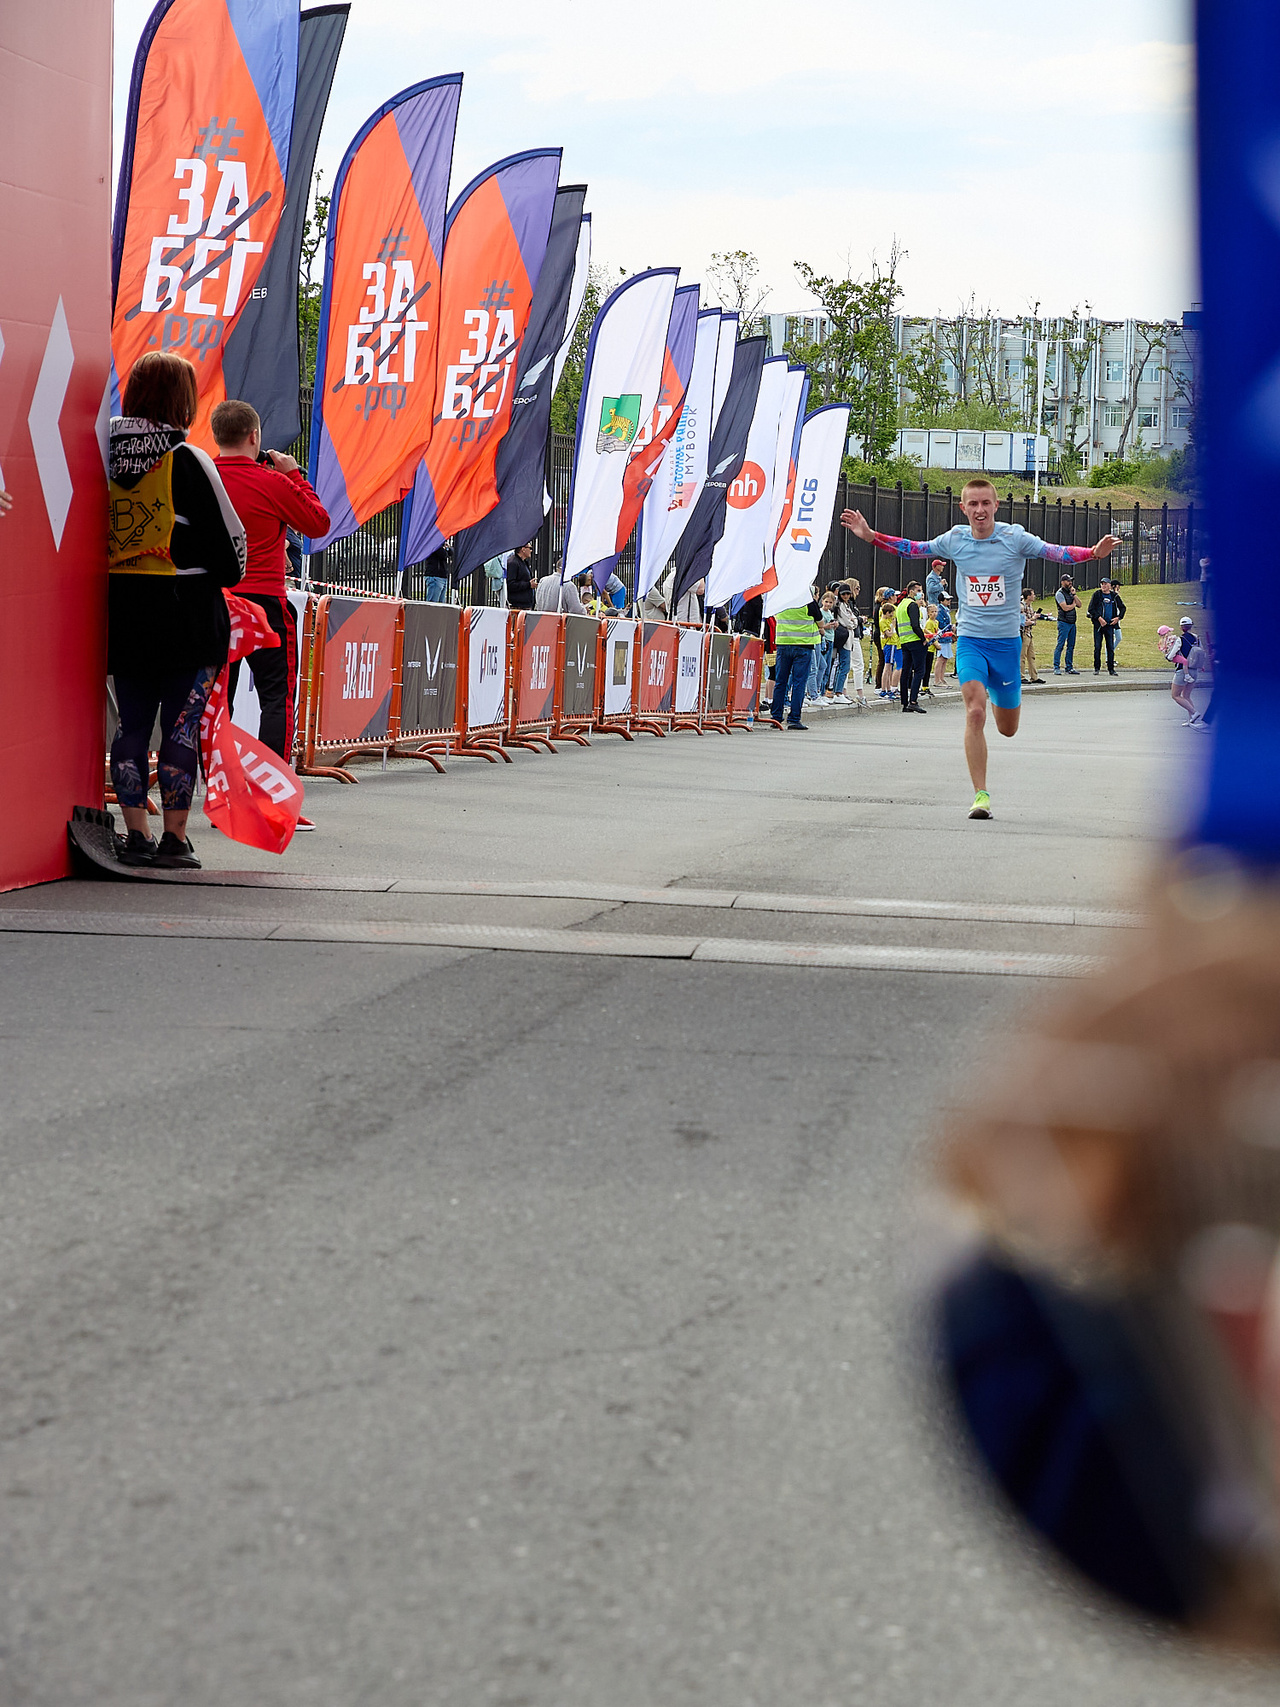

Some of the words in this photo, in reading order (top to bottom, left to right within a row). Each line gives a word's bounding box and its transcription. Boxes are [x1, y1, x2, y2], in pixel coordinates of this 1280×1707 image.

[166, 158, 250, 240] ЗА
[140, 236, 264, 317] БЕГ
[359, 260, 418, 324] ЗА
[344, 321, 429, 385] БЕГ
[459, 309, 516, 364] ЗА
[684, 408, 698, 475] MYBOOK
[797, 478, 819, 522] ПСБ
[970, 583, 1000, 593] 20785
